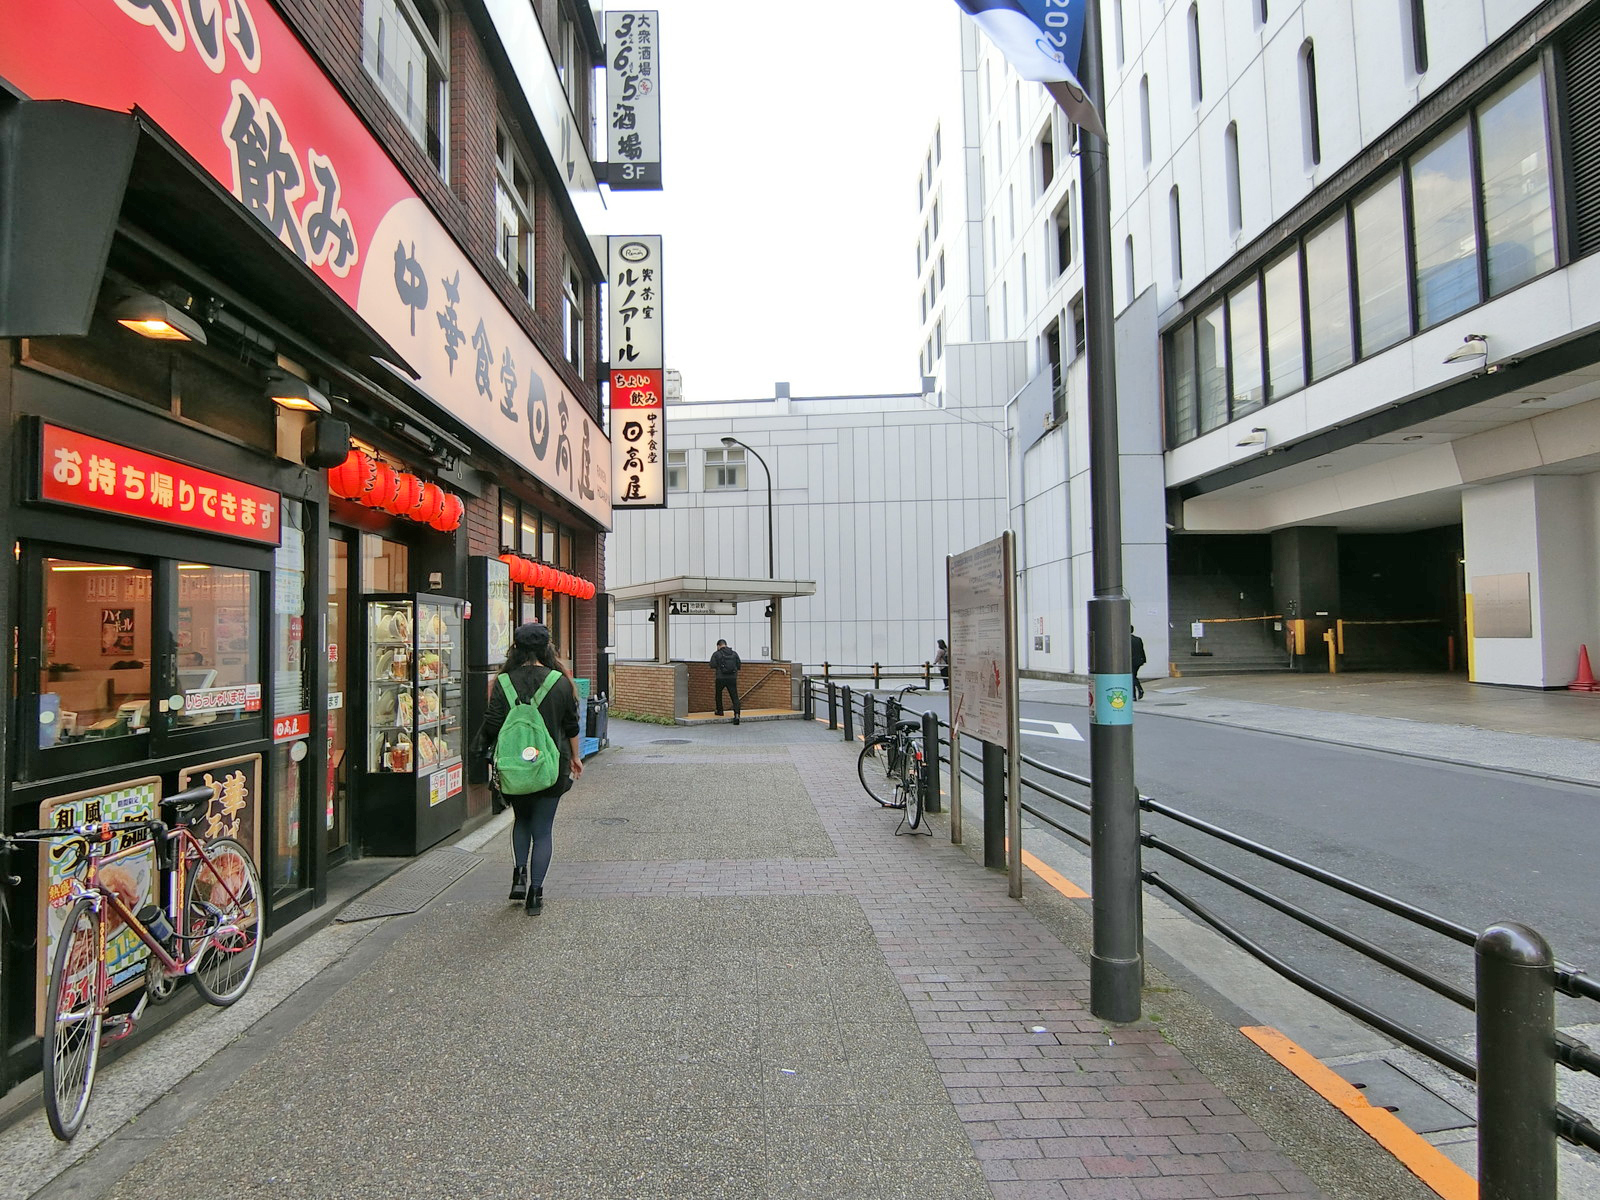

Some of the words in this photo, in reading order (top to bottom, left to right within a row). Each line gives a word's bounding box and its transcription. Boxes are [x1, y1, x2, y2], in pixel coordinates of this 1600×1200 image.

[637, 14, 651, 76] 大衆酒場
[222, 79, 358, 278] 飲み
[622, 163, 646, 180] 3F
[393, 239, 519, 424] 中華食堂
[617, 268, 640, 362] ルノアール
[615, 374, 650, 388] ちょい
[630, 391, 657, 405] 飲み
[647, 412, 658, 464] 中華食堂
[53, 447, 275, 529] お持ち帰りできます
[102, 609, 121, 623] ハイ
[185, 689, 247, 711] いらっしゃいませ
